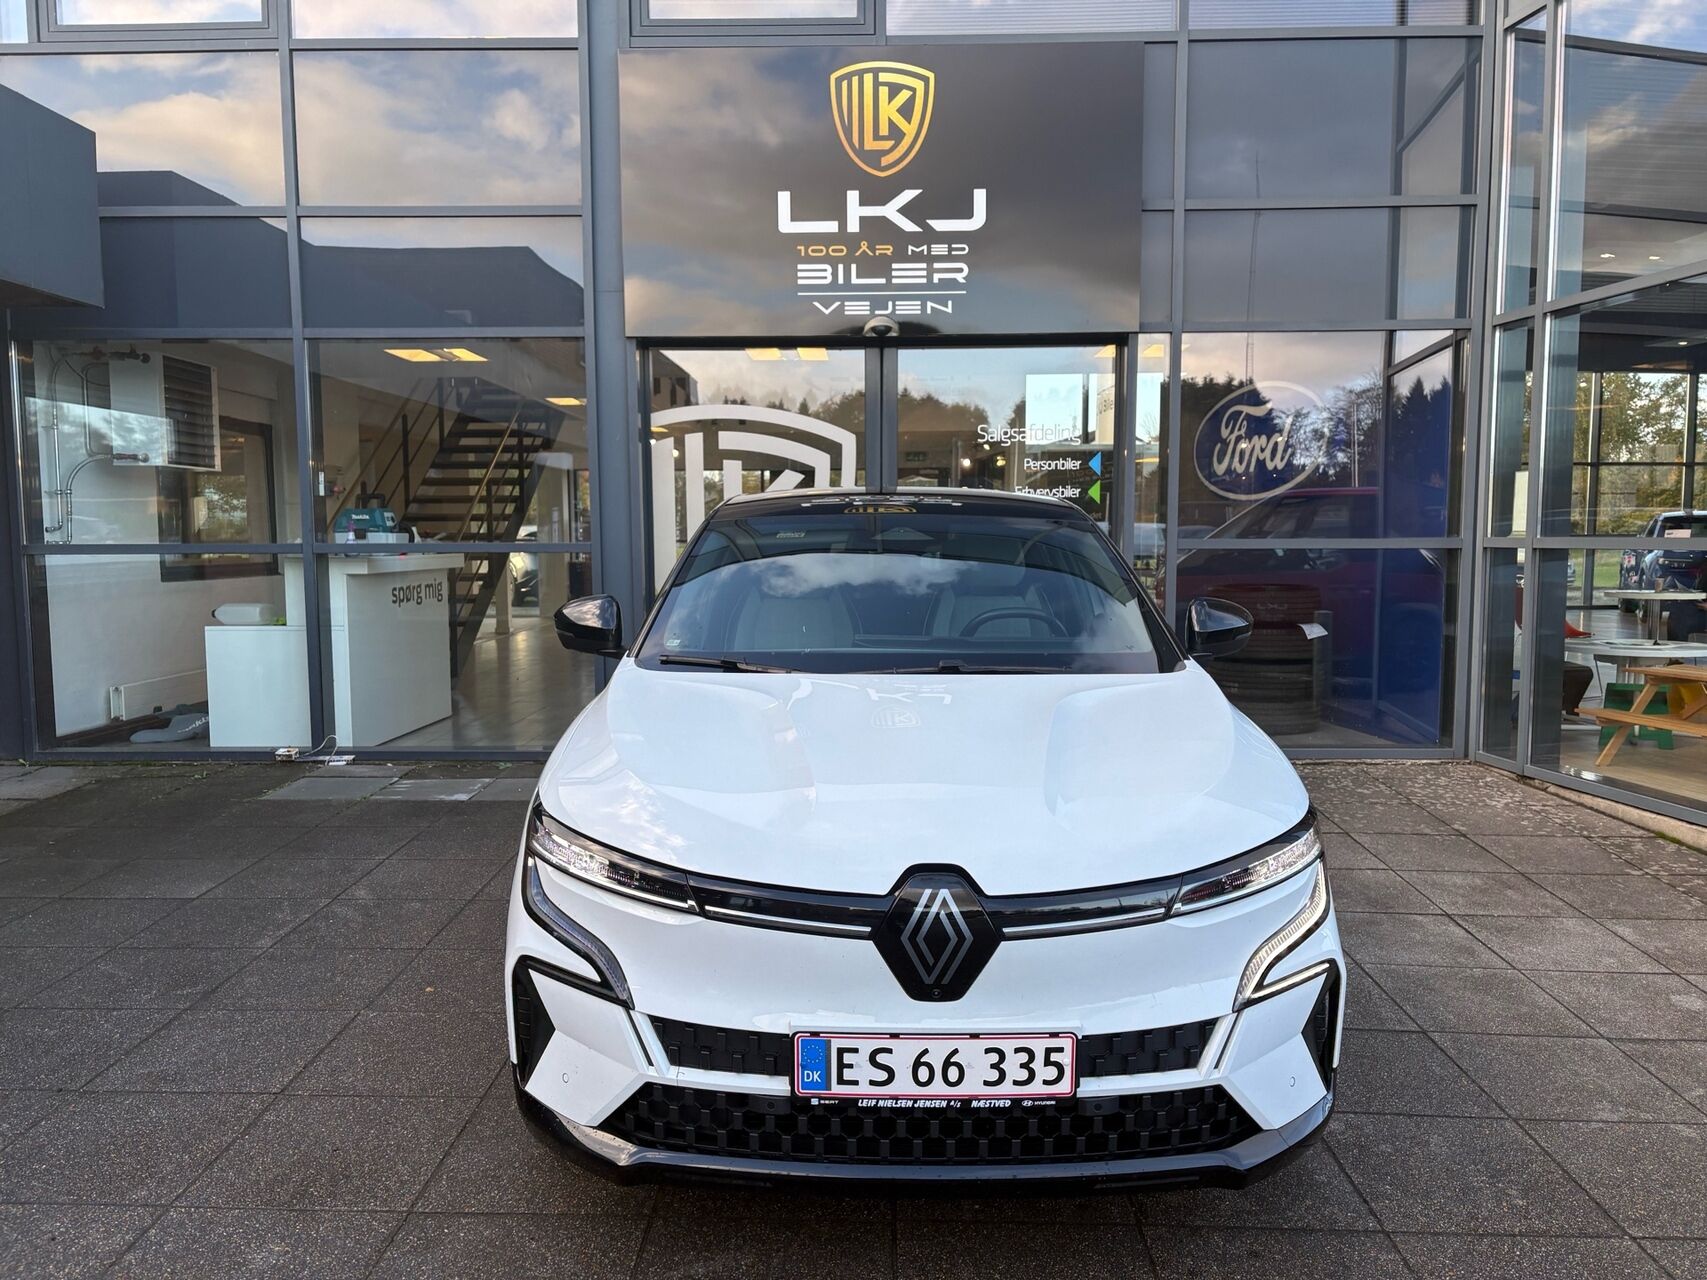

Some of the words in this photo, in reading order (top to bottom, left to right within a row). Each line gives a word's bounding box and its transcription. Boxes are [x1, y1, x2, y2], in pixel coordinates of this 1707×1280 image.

[777, 188, 987, 233] LKJ
[797, 245, 847, 257] 100
[855, 240, 894, 256] ÅR
[908, 243, 970, 255] MED
[797, 262, 970, 284] BILER
[812, 300, 953, 315] VEJEN
[977, 424, 1081, 447] Salgsafdeling
[1213, 401, 1294, 476] Ford
[1024, 457, 1082, 470] Personbiler
[391, 583, 423, 608] spørg
[425, 578, 443, 602] mig
[804, 1070, 822, 1082] DK
[836, 1046, 896, 1088] ES
[911, 1047, 966, 1088] 66
[982, 1046, 1066, 1088] 335
[858, 1099, 877, 1107] LEIF
[877, 1100, 914, 1108] NIELSEN
[914, 1100, 948, 1108] JENSEN
[971, 1100, 1012, 1108] NÆSTVED
